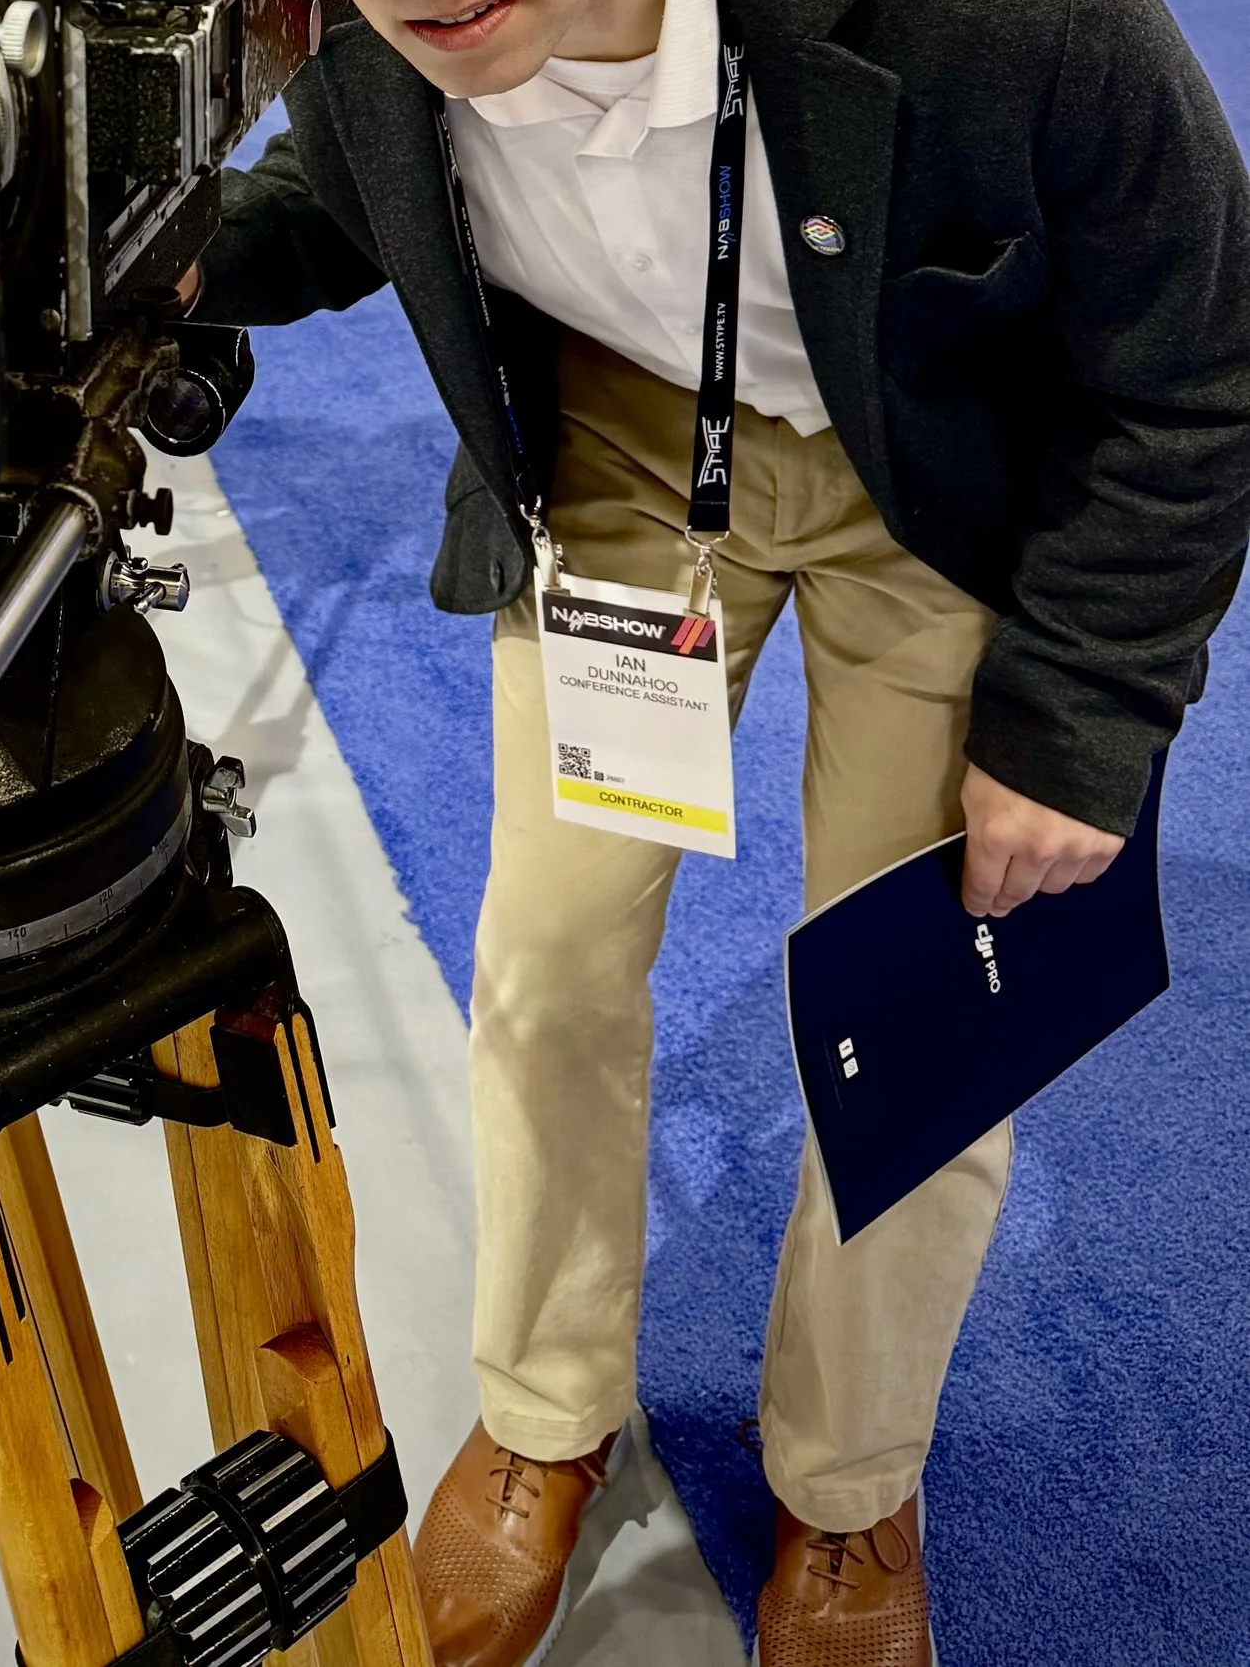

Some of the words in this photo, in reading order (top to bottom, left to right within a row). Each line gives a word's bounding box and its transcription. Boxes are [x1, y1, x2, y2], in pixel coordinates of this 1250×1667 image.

[719, 43, 745, 125] STYPE
[717, 164, 734, 260] NABSHOW
[714, 301, 727, 381] WWW.STYPE.TV
[697, 415, 730, 489] STYPE
[551, 605, 666, 640] NABSHOW
[587, 665, 679, 695] DUNNAHOO
[615, 653, 647, 673] IAN
[559, 674, 641, 700] CONFERENCE
[642, 692, 710, 713] ASSISTANT
[599, 790, 684, 819] CONTRACTOR
[7, 926, 27, 941] 140
[984, 959, 1001, 995] PRO
